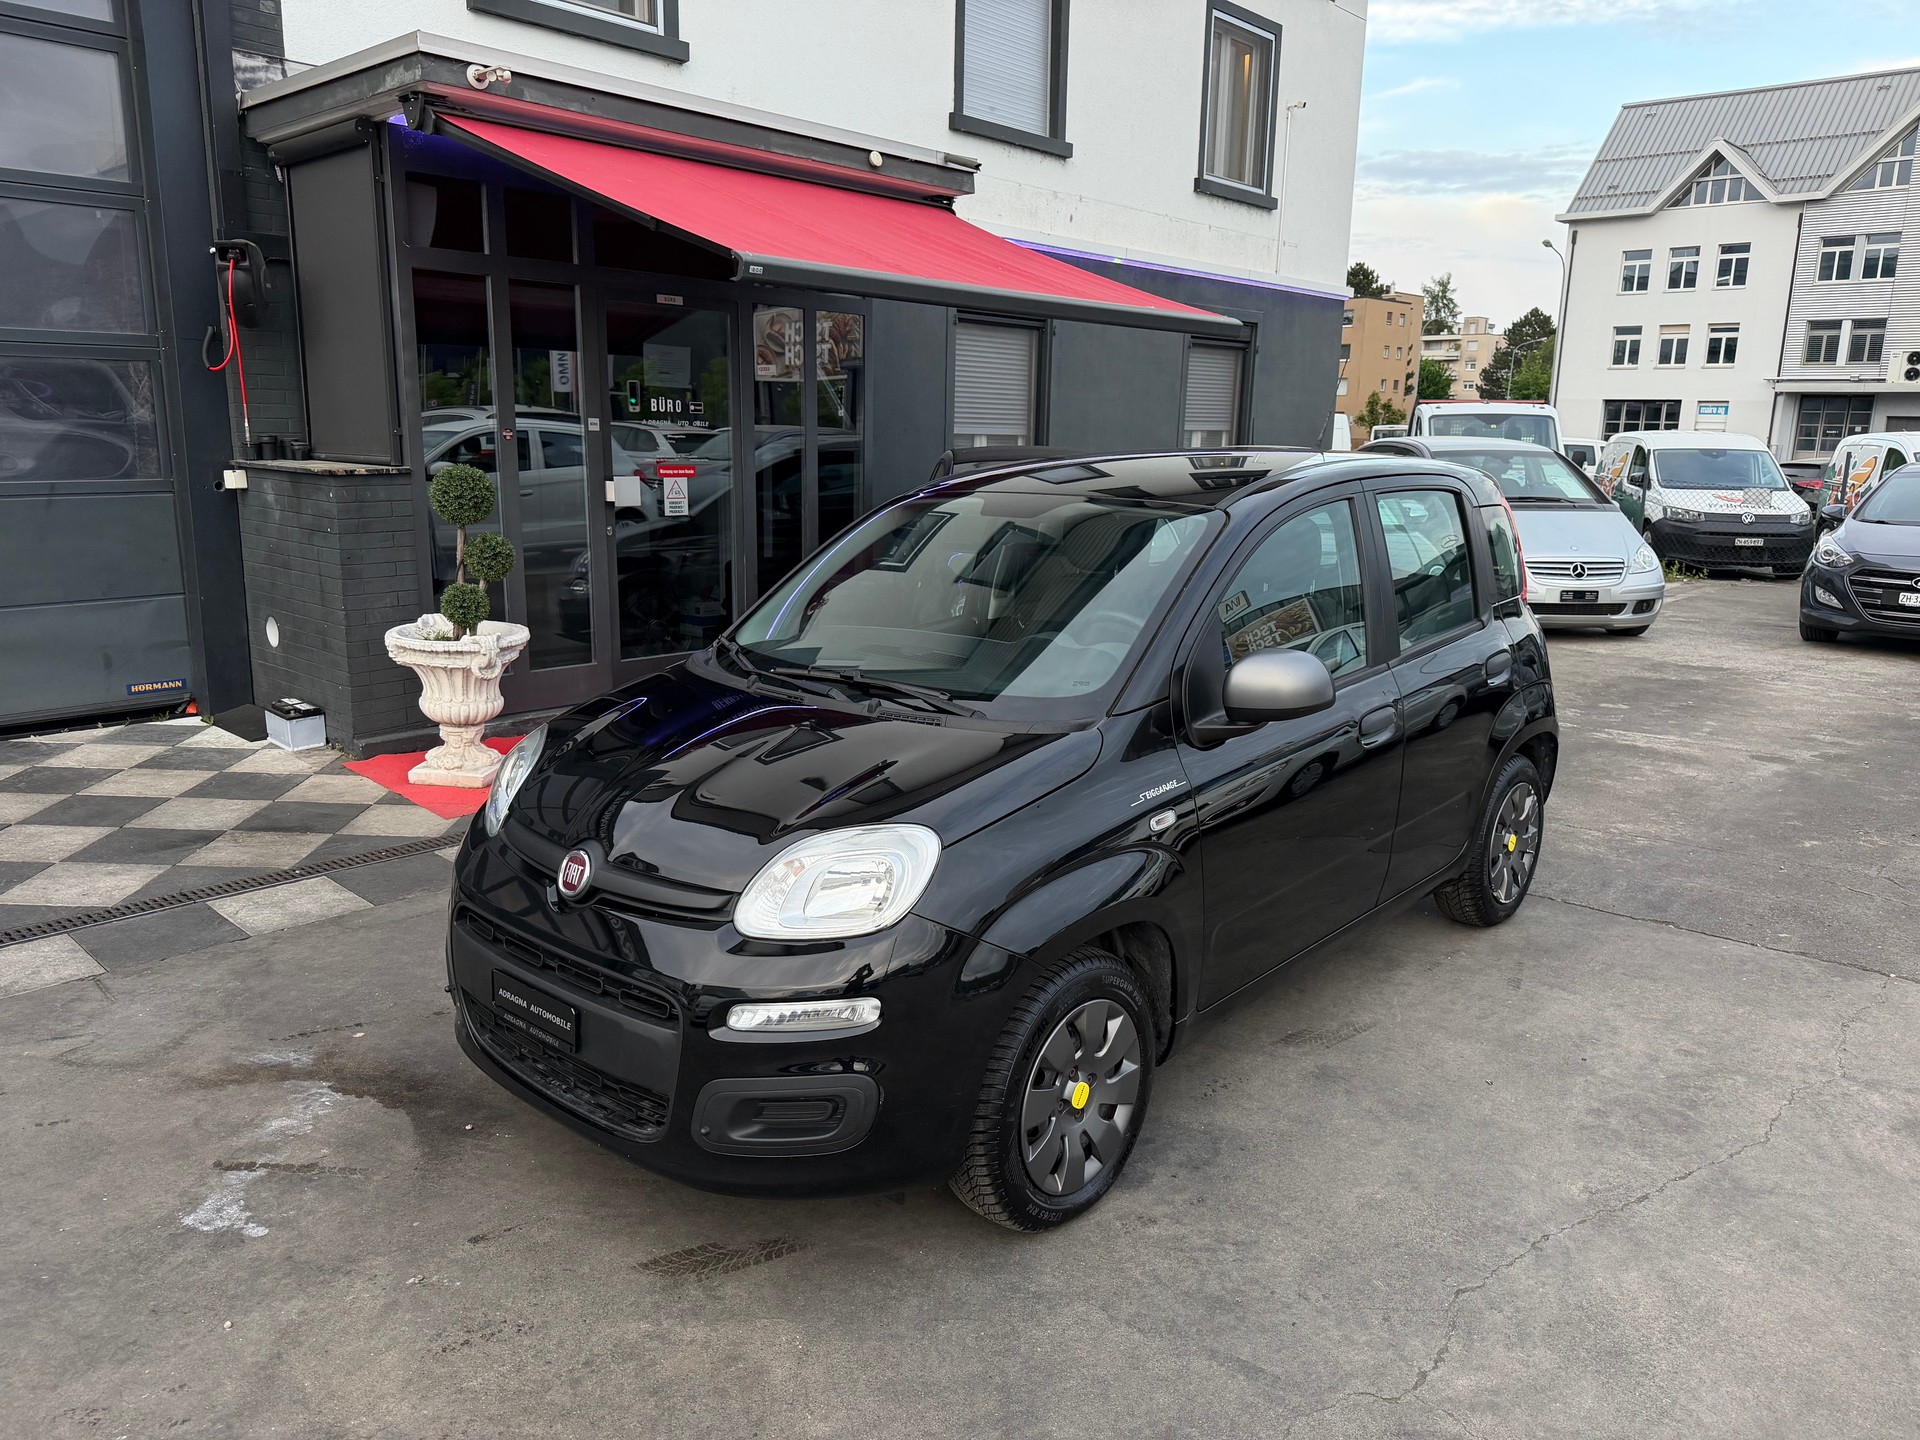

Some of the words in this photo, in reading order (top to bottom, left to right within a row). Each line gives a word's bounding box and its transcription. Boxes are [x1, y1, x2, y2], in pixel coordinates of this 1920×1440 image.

[650, 396, 682, 413] BÜRO
[563, 861, 584, 886] FIAT
[498, 988, 528, 1009] ADRAGNA
[529, 1004, 572, 1031] AUTOMOBILE
